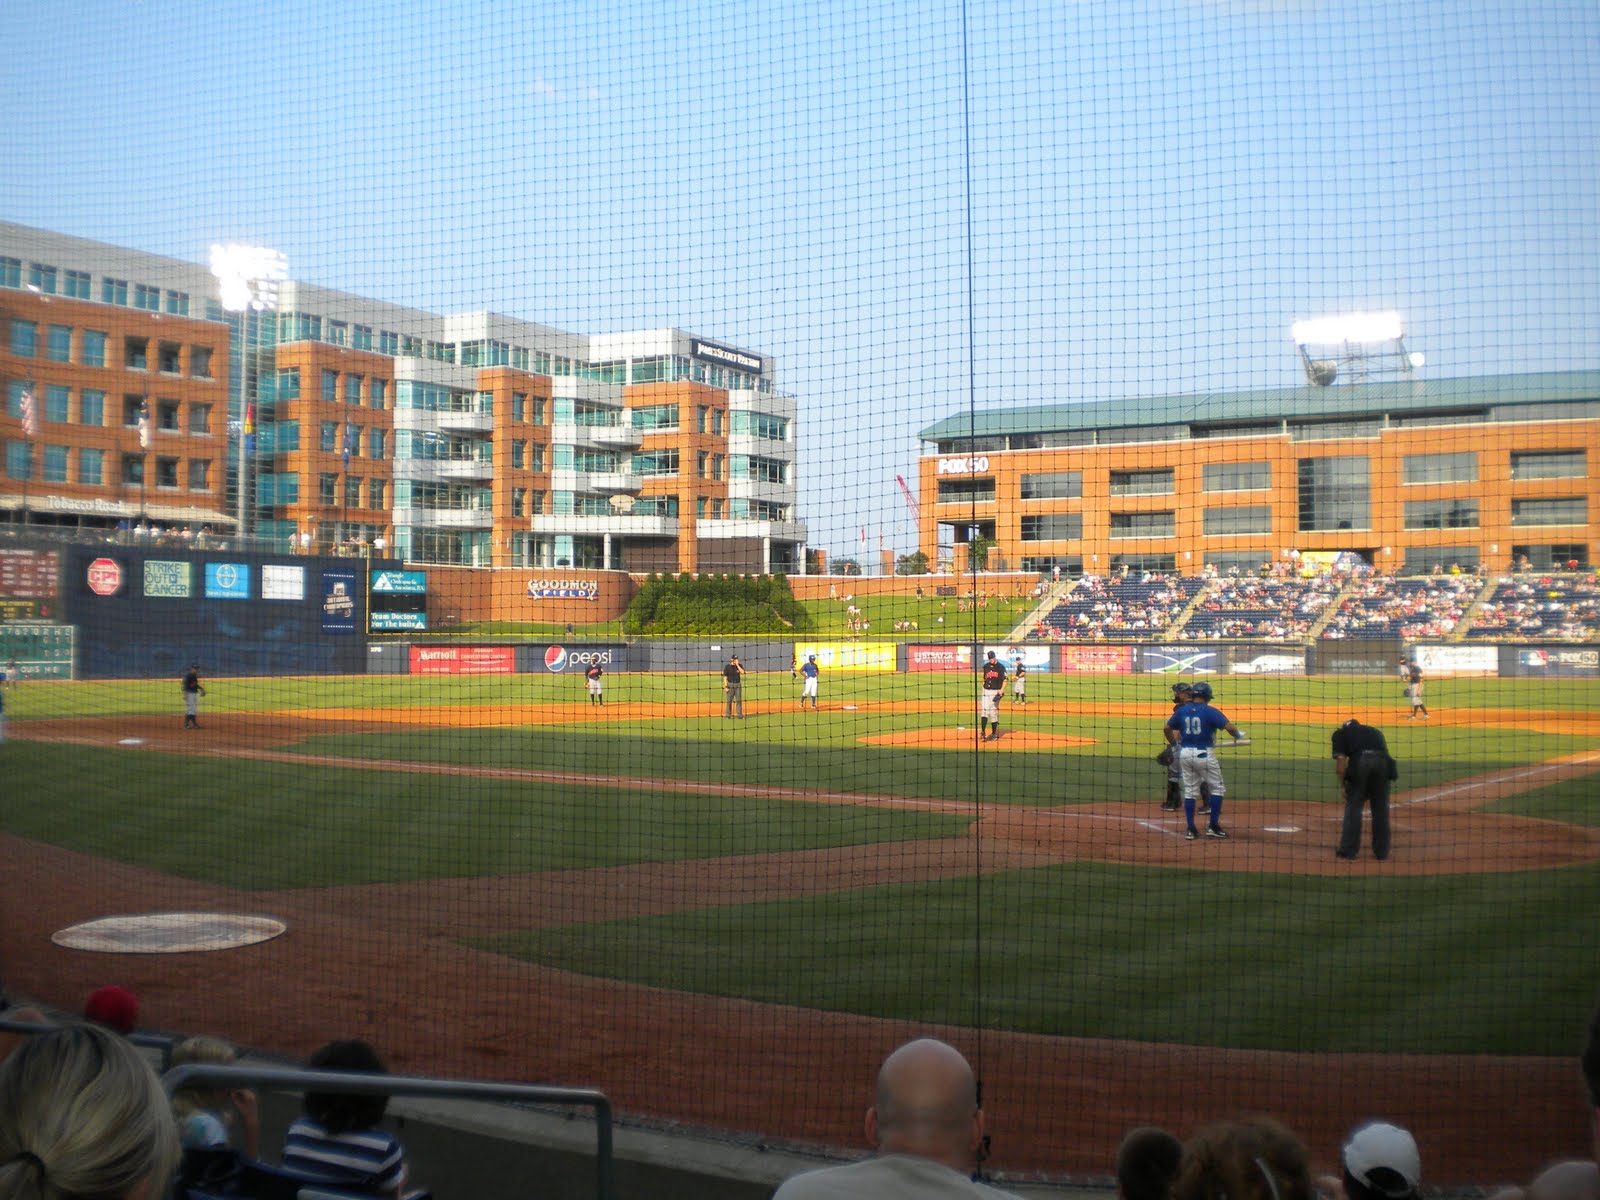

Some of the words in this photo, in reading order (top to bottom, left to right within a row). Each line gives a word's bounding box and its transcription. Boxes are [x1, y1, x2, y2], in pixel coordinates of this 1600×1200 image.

[938, 458, 969, 474] FOX
[969, 456, 989, 472] 50
[144, 562, 181, 574] STRIKE
[144, 572, 168, 584] OUT
[144, 583, 187, 595] CANCER
[370, 612, 390, 620] Team
[391, 612, 418, 620] Doctors
[568, 649, 612, 668] pepsi
[1184, 716, 1202, 735] 10
